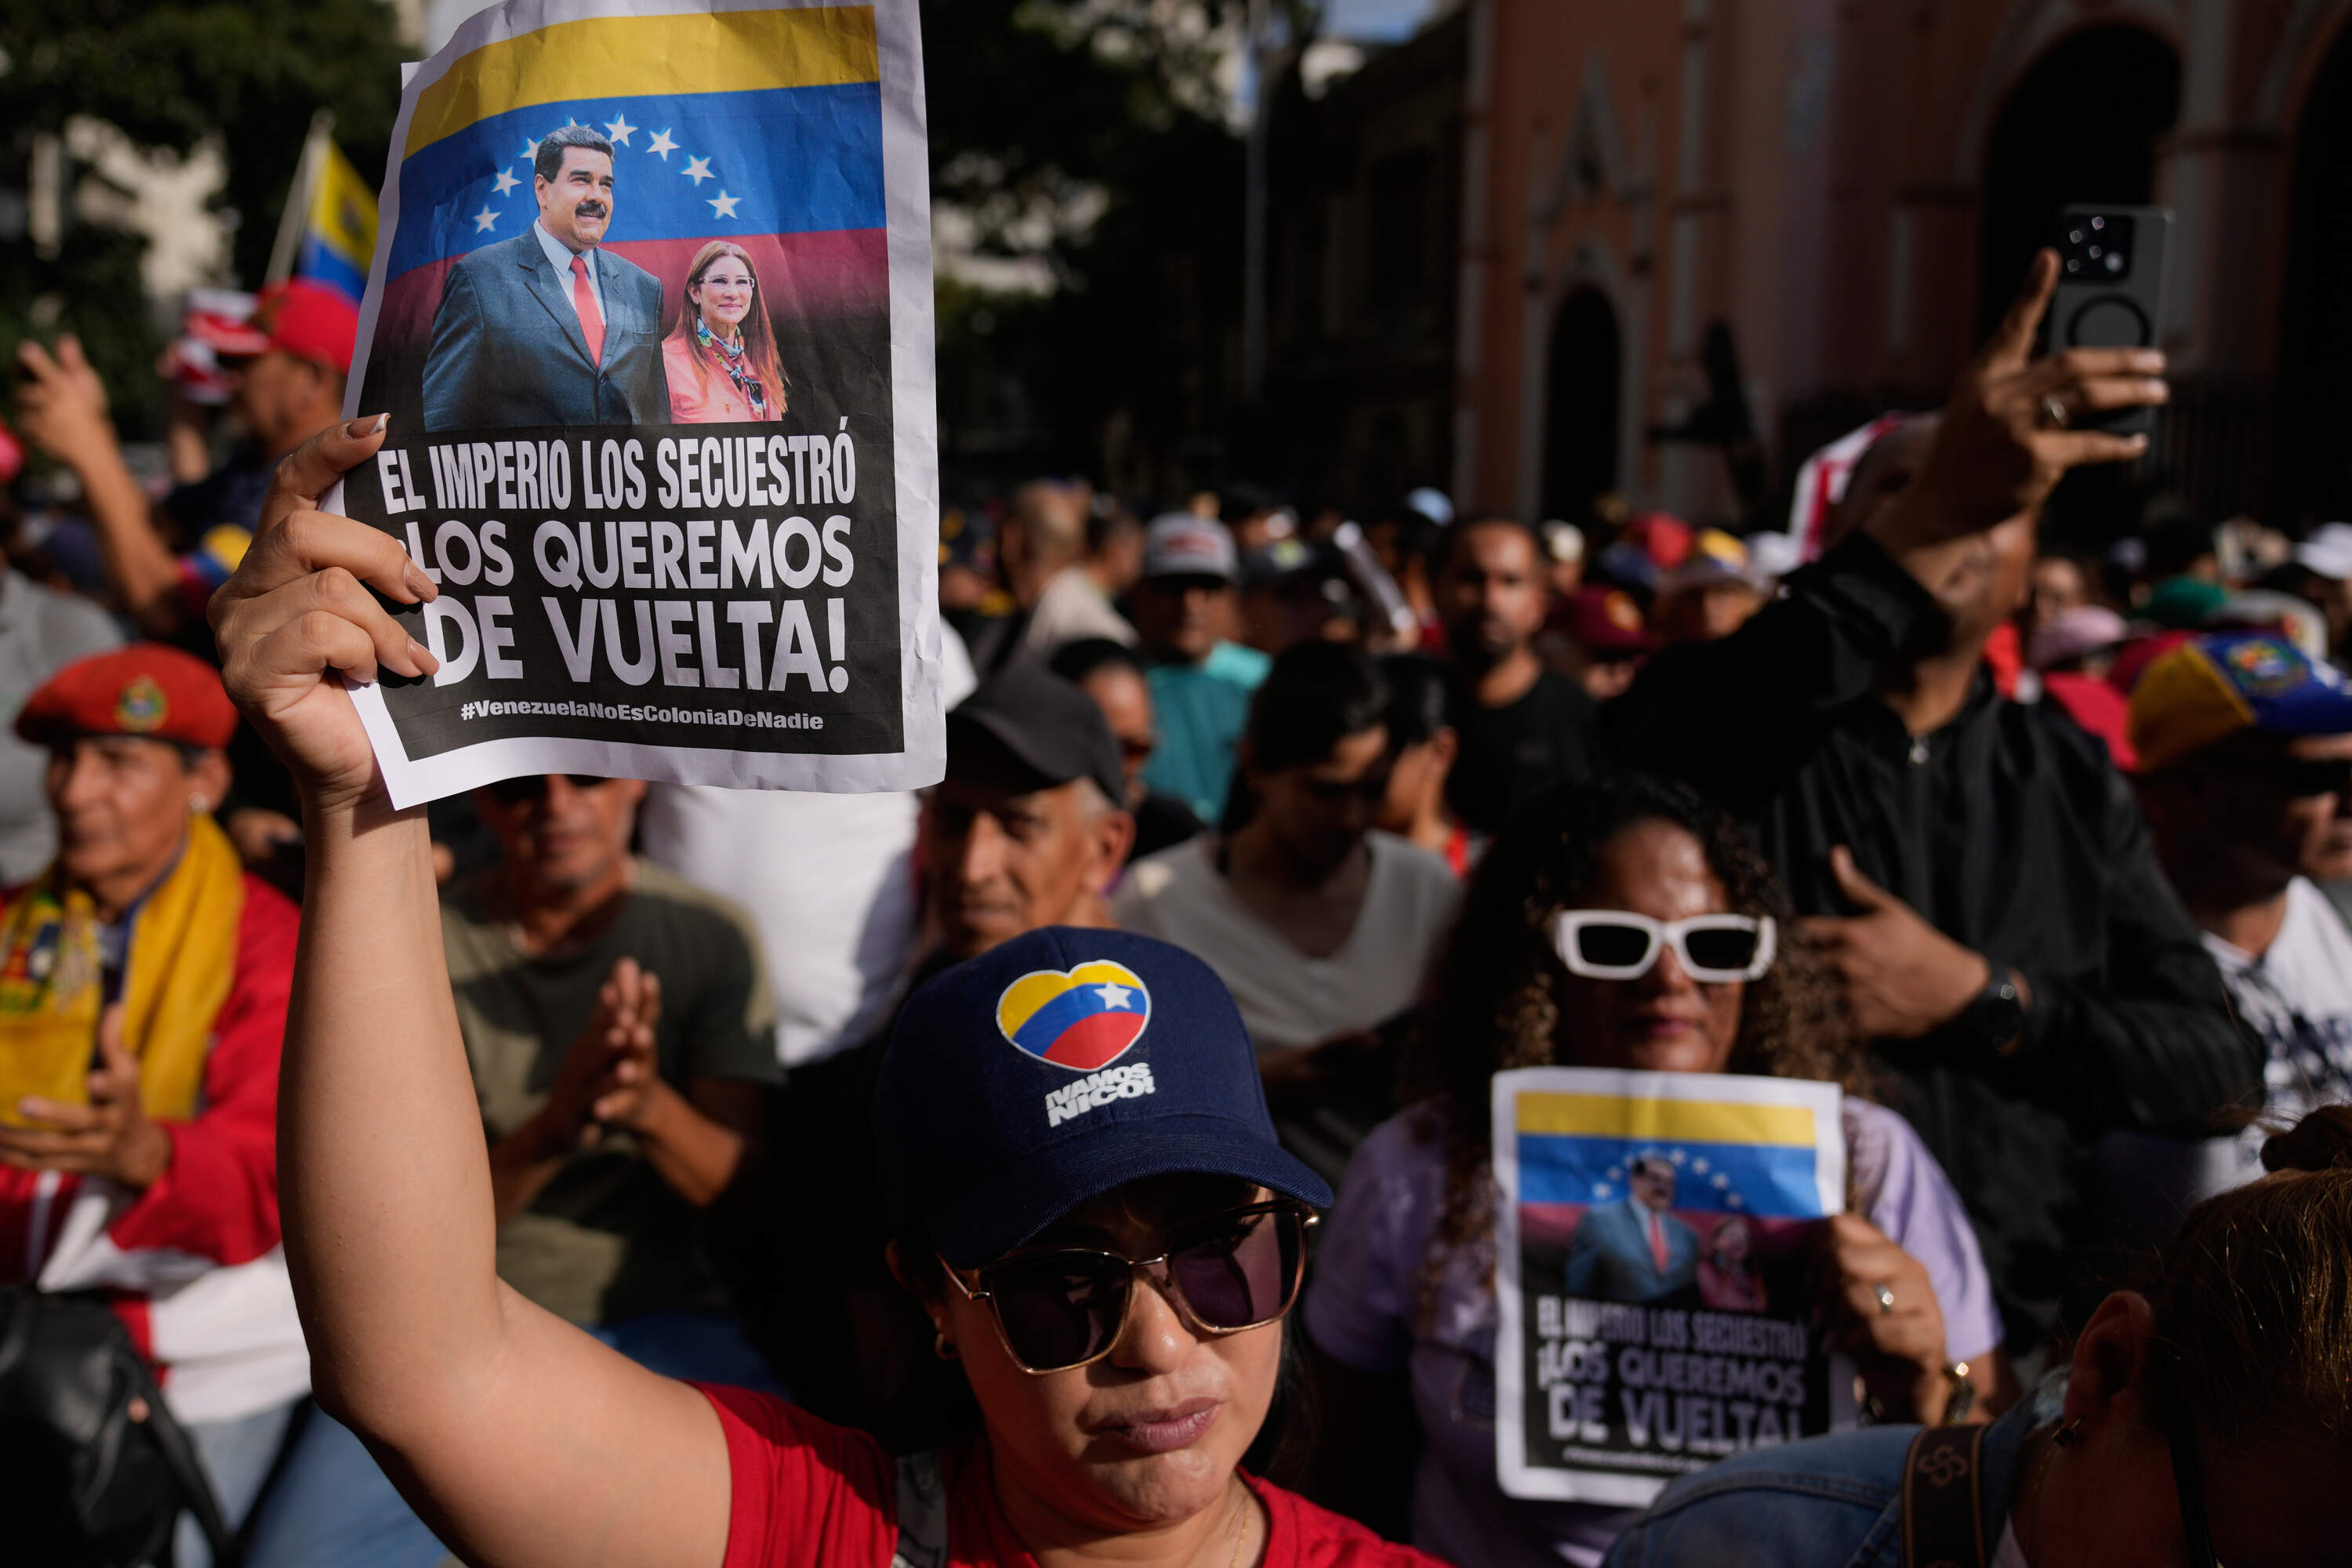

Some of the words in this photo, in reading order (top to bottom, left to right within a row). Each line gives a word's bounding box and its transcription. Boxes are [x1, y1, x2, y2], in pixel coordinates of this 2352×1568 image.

[378, 449, 426, 514] EL
[429, 438, 572, 510] IMPERIO
[582, 439, 645, 510] LOS
[656, 416, 856, 510] SECUESTRÓ
[397, 519, 514, 587] LOS
[533, 515, 855, 593] QUEREMOS
[423, 594, 524, 688] DE
[542, 597, 848, 695] VUELTA!
[461, 699, 824, 730] #VenezuelaNoEsColoniaDeNadie
[1047, 1076, 1156, 1127] NICO!
[1537, 1295, 1563, 1338] EL
[1650, 1308, 1687, 1349] LOS
[1618, 1347, 1806, 1406] QUEREMOS
[1548, 1381, 1609, 1443] DE
